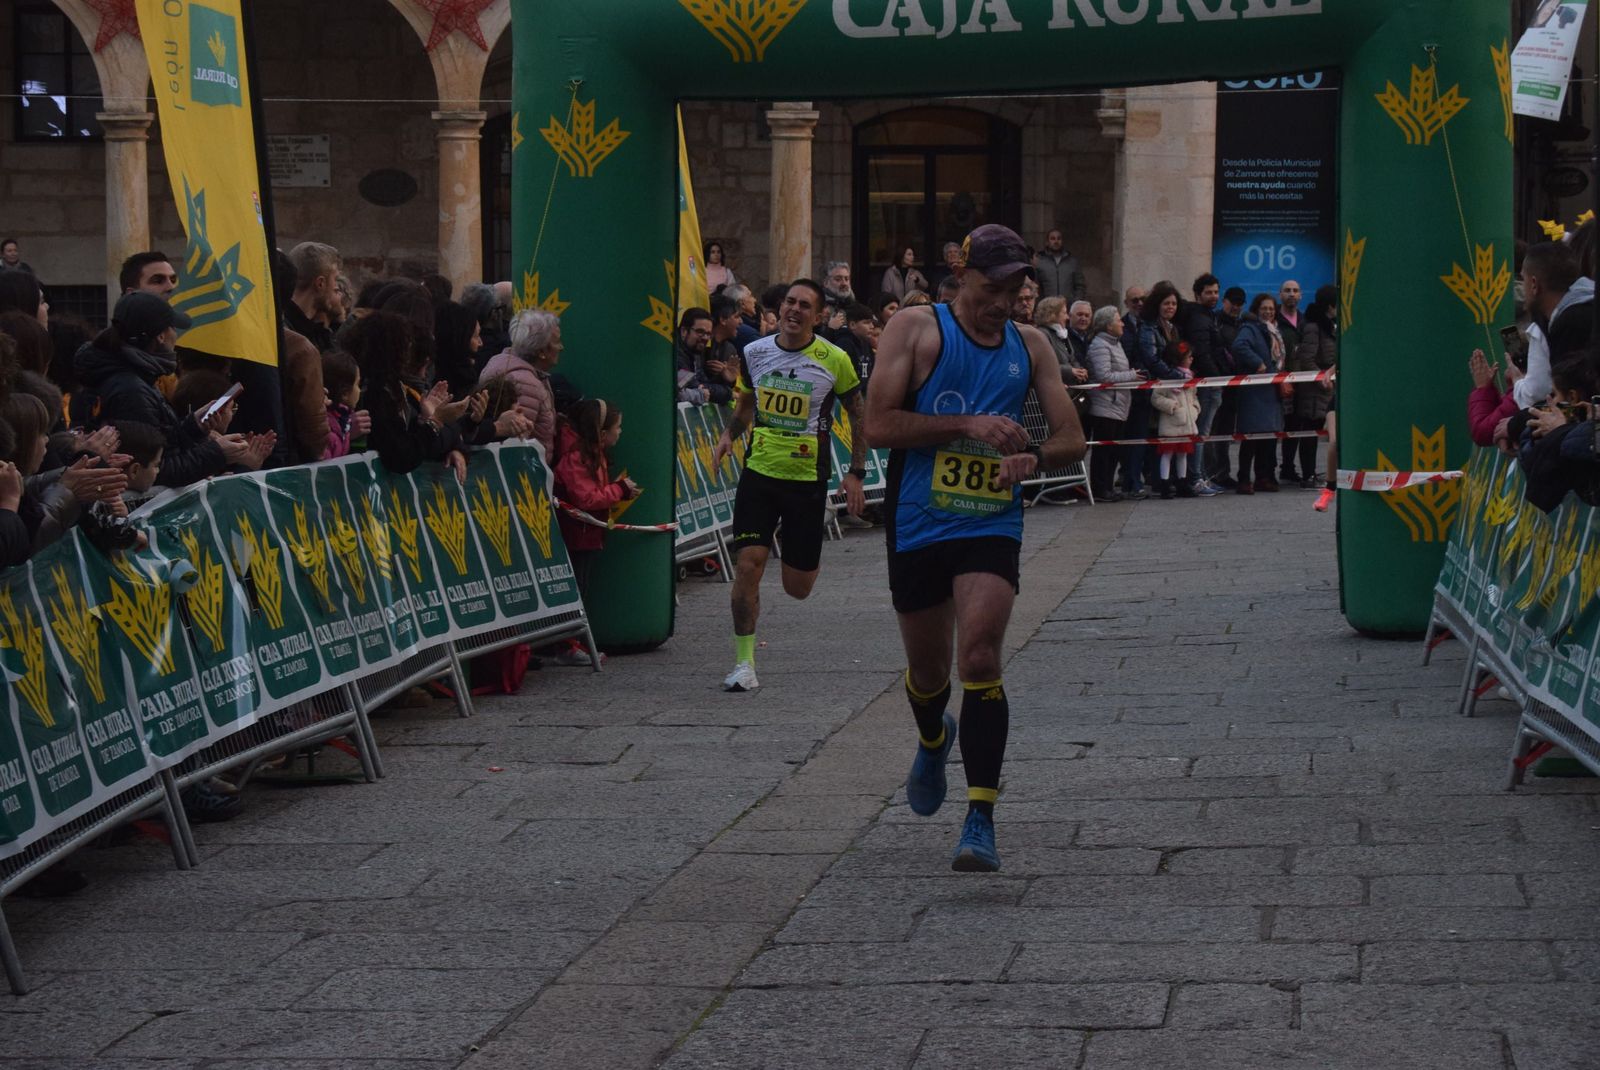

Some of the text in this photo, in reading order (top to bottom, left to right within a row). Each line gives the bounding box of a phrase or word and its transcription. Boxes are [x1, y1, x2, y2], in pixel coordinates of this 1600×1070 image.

[1222, 158, 1248, 167] Desde
[1249, 158, 1256, 167] la
[1283, 158, 1321, 169] Municipal
[1224, 169, 1319, 178] de Zamora te ofrecemos
[1257, 191, 1265, 200] la
[1265, 191, 1304, 200] necesitas
[1260, 181, 1286, 190] ayuda
[1287, 181, 1317, 189] cuando
[1243, 244, 1297, 270] 016
[763, 391, 803, 416] 700
[941, 456, 1008, 493] 385
[953, 498, 976, 510] CAJA
[279, 631, 313, 659] RURAL
[139, 690, 176, 722] CAJA
[85, 719, 109, 748] CAJA
[158, 717, 177, 736] DE
[31, 731, 83, 775] CAJA RURAL
